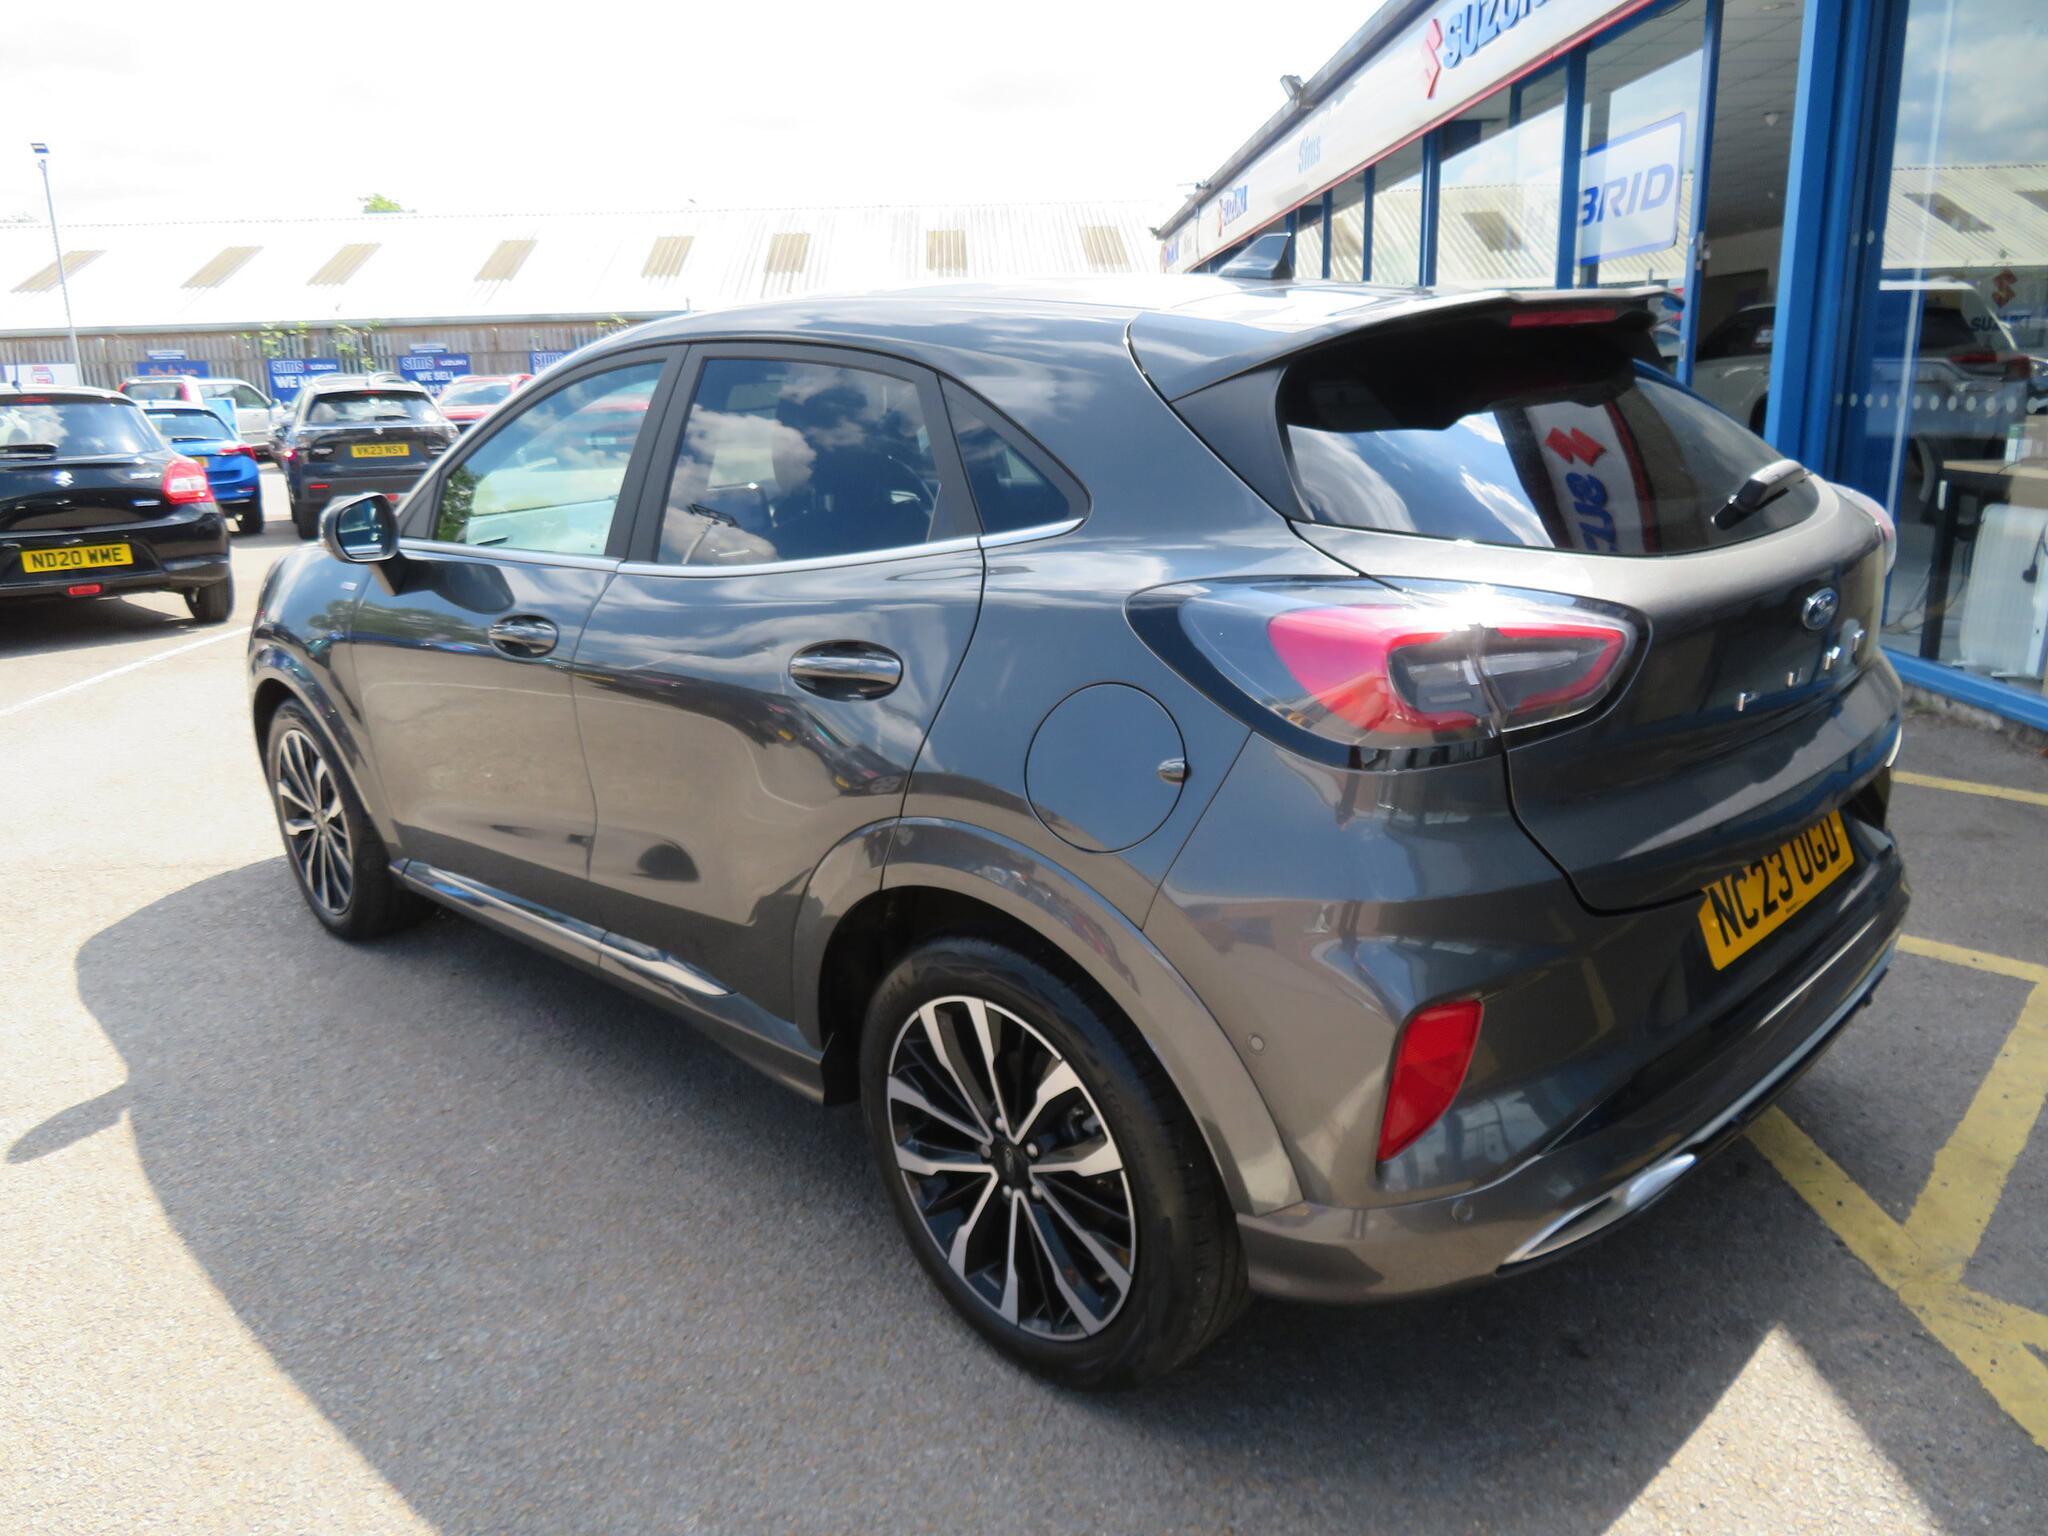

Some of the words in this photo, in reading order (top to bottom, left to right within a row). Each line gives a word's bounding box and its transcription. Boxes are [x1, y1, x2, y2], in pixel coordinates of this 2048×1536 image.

[273, 375, 299, 388] WE
[31, 551, 82, 569] ND20
[87, 547, 124, 565] WME
[1707, 853, 1794, 948] NC23
[1789, 815, 1841, 886] UGD
